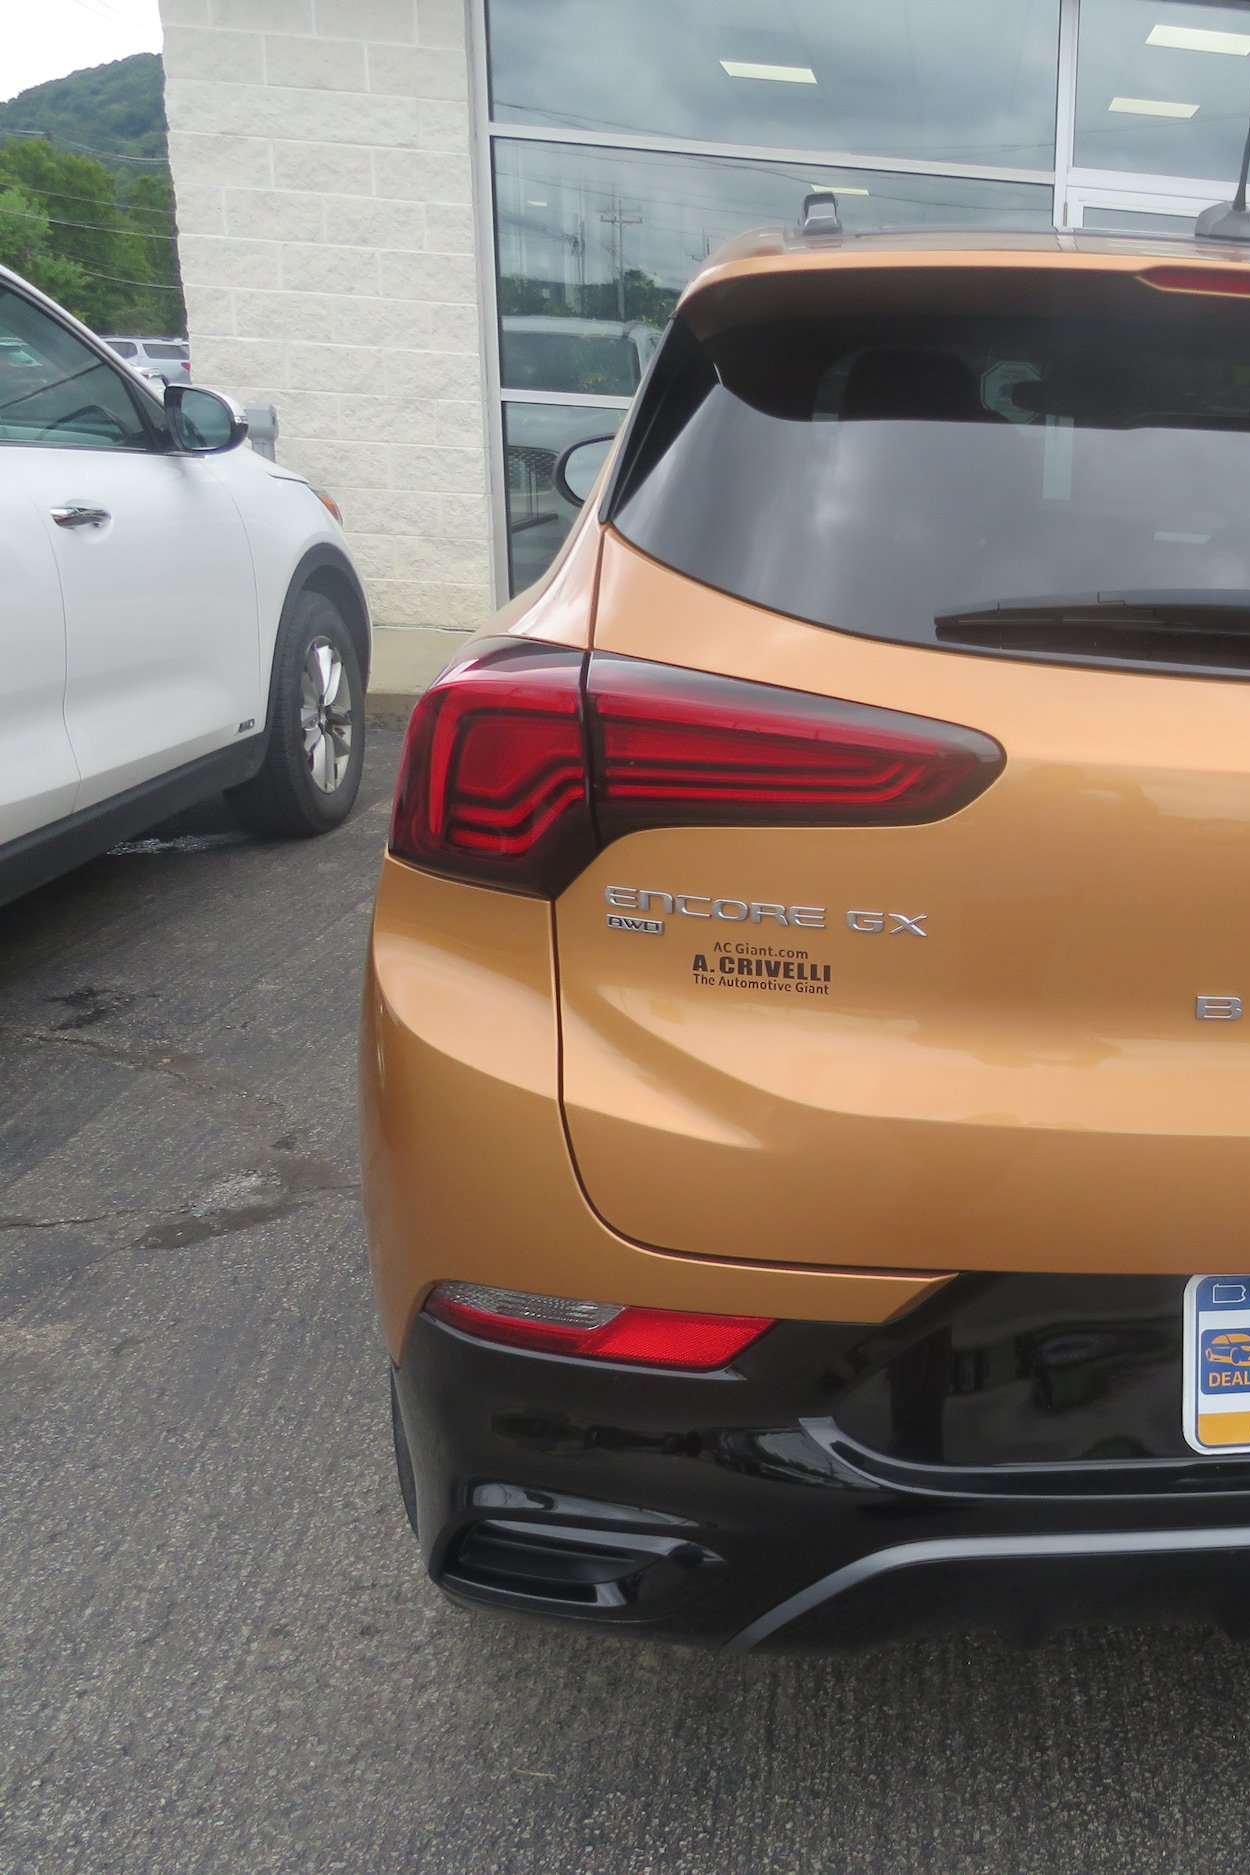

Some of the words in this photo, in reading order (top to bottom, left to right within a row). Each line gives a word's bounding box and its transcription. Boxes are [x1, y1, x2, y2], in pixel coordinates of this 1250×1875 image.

[605, 885, 827, 928] ENCORE
[846, 910, 929, 938] GX
[607, 915, 662, 934] AWD
[713, 941, 732, 953] AC
[735, 943, 809, 960] Giant.com
[692, 954, 715, 973] A.
[719, 956, 831, 982] CRIVELLI
[693, 973, 715, 986] The
[718, 976, 792, 992] Automotive
[795, 982, 829, 995] Giant
